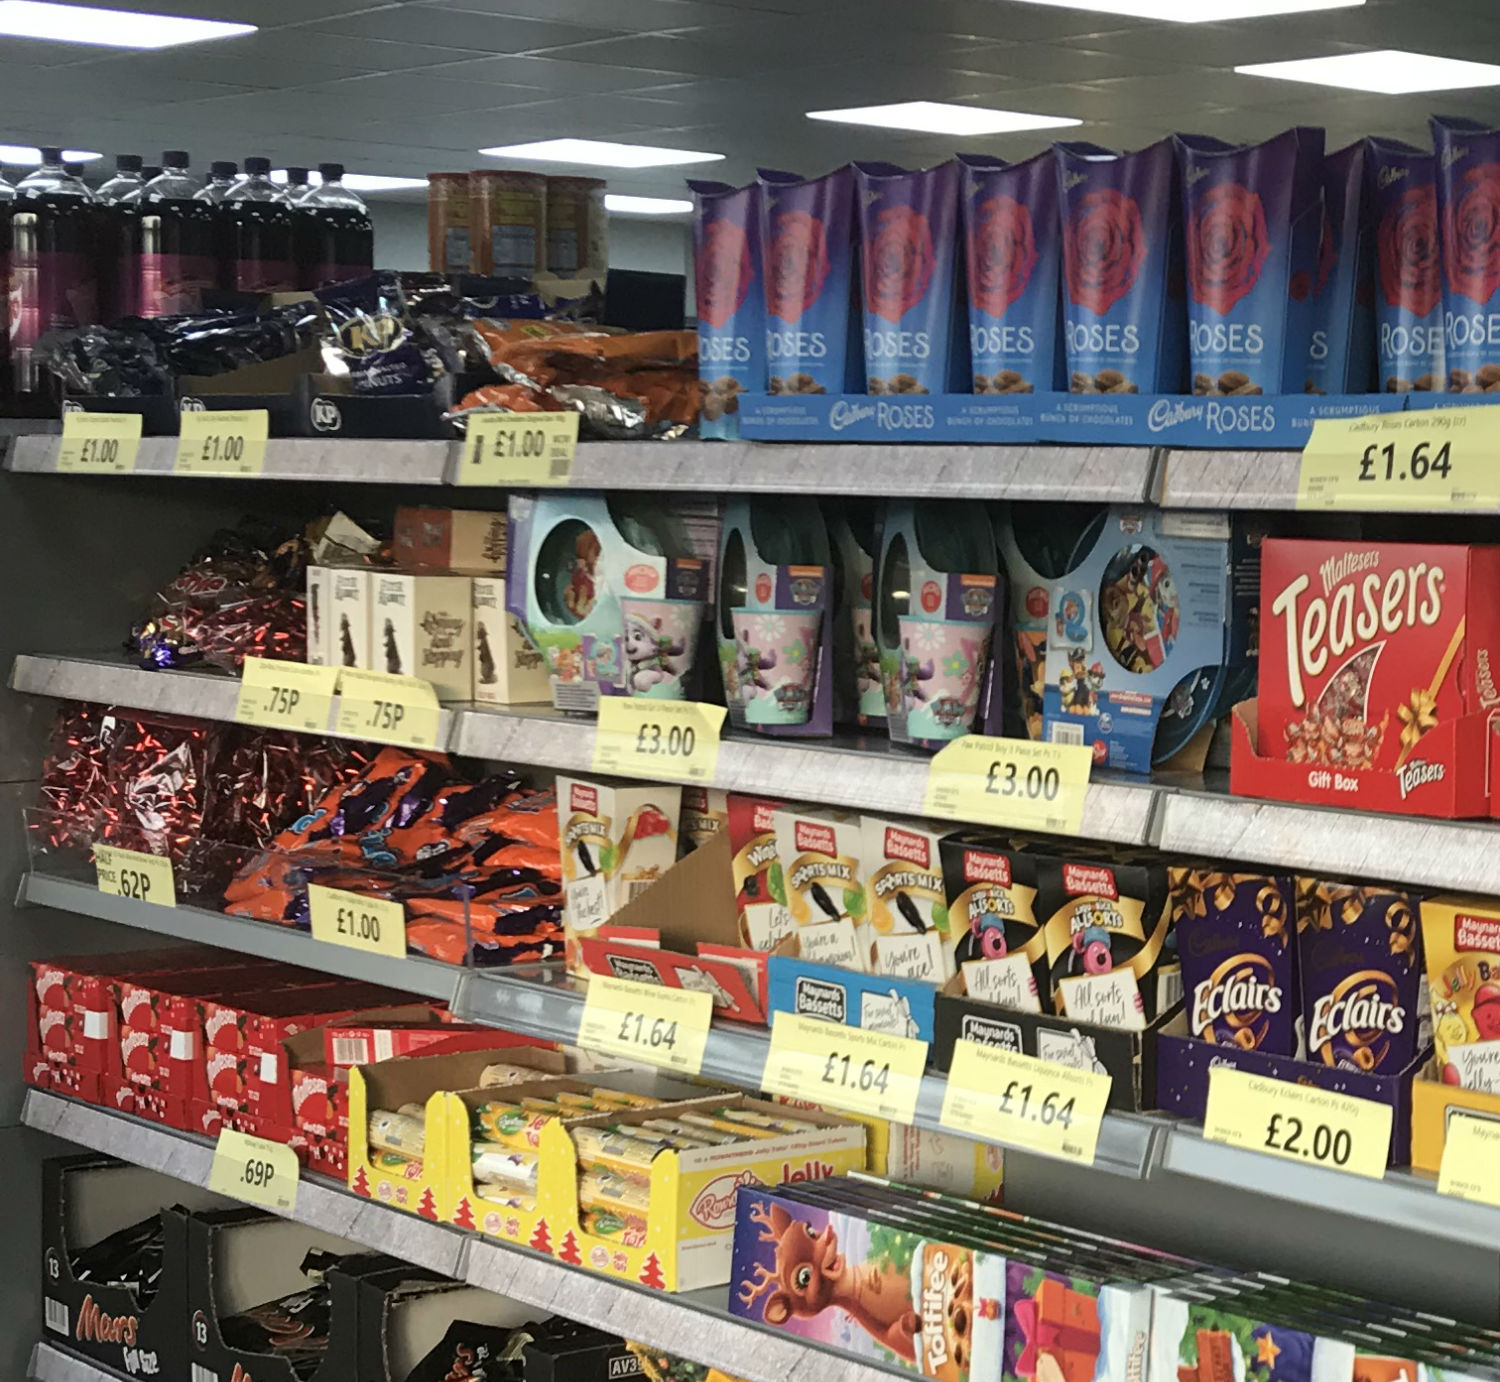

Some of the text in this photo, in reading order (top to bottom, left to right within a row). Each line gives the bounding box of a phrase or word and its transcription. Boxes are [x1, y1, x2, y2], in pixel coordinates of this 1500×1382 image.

[1067, 322, 1139, 354] ROSES
[1191, 321, 1264, 354] ROSES
[1381, 325, 1443, 356] ROSE
[314, 403, 336, 426] KP
[877, 402, 935, 431] ROSES
[1147, 399, 1275, 434] Cadbury ROSES
[80, 438, 119, 463] £1.00
[201, 436, 244, 461] £1.00
[494, 430, 545, 458] £1.00
[1359, 441, 1452, 482] £1.64
[1320, 550, 1380, 597] Maltesers
[1272, 562, 1444, 708] Teasers
[264, 687, 300, 715] .75P
[366, 700, 404, 730] .75P
[636, 723, 696, 757] £3.00
[985, 761, 1060, 801] £3.00
[1308, 771, 1359, 793] Gift Box
[1396, 762, 1444, 800] Teasers
[831, 862, 851, 880] MIX
[965, 850, 1008, 870] Maynards
[965, 863, 1010, 886] Bassetts
[1065, 864, 1110, 886] Maynards
[118, 868, 151, 901] .62P
[917, 874, 944, 894] MIX
[1064, 877, 1117, 899] Bassetts
[968, 897, 1016, 919] ALLSORTS
[1070, 909, 1124, 934] ALLSORTS
[337, 909, 380, 944] £1.00
[800, 978, 843, 1002] Maynards
[1442, 964, 1477, 999] Jelly
[798, 993, 844, 1020] Bassetts
[1192, 974, 1284, 1037] Eclairs
[618, 1011, 678, 1050] £1.64
[1309, 993, 1407, 1052] Eclairs
[821, 1051, 890, 1095] £1.64
[998, 1080, 1077, 1131] £1.64
[1264, 1112, 1353, 1166] £2.00
[239, 1156, 275, 1189] .69P
[784, 1161, 833, 1184] Jelly
[48, 1257, 60, 1280] 13
[76, 1295, 139, 1346] Mars
[925, 1248, 950, 1370] Toffifee
[195, 1321, 208, 1346] 13
